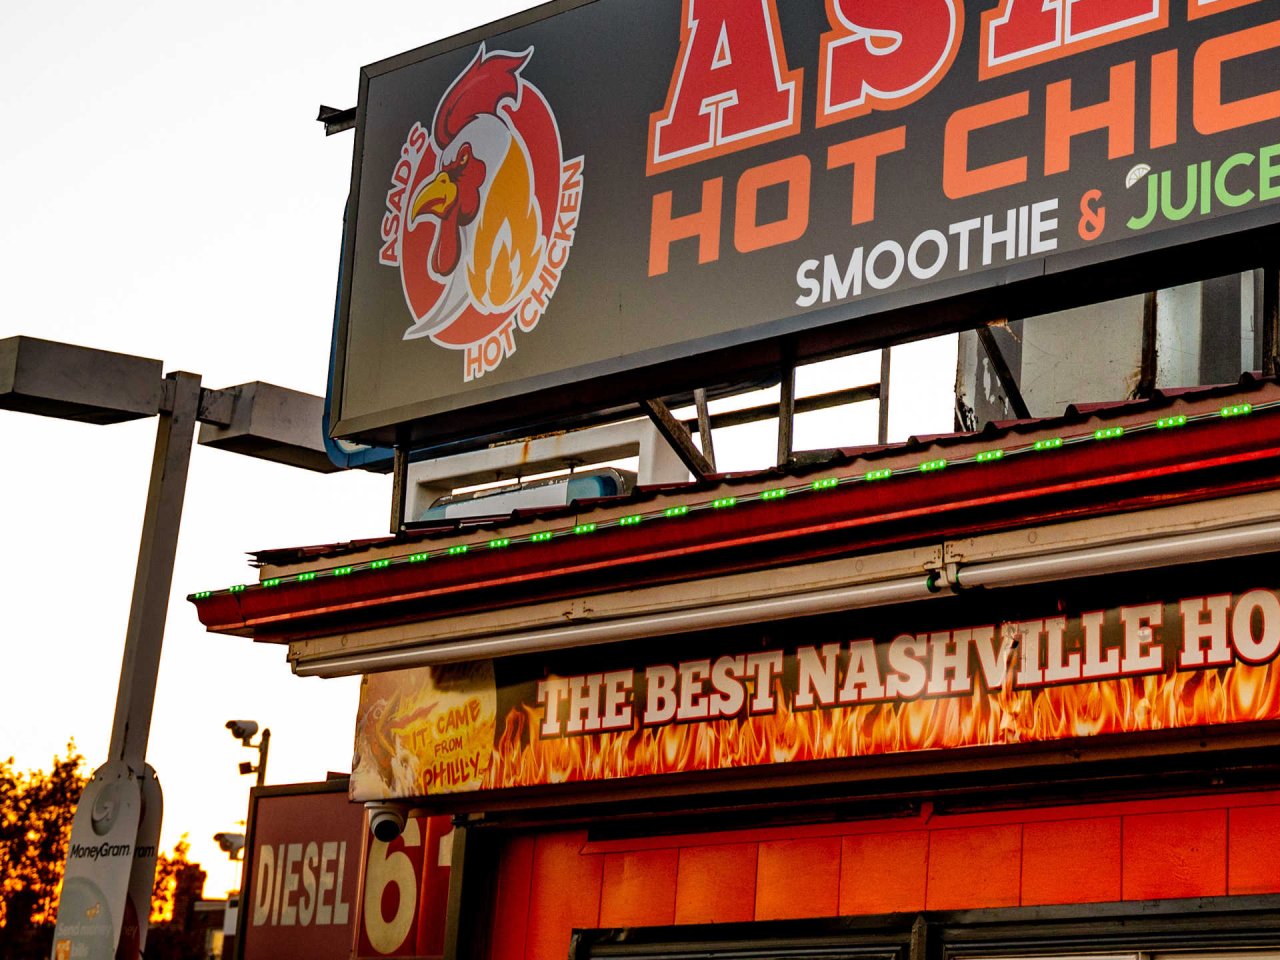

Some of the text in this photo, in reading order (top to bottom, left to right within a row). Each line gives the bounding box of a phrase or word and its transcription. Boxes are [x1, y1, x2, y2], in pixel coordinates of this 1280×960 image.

[380, 125, 428, 263] ASAD'S
[648, 124, 906, 276] HOT
[465, 159, 583, 378] HOT CHICKEN
[795, 198, 1059, 307] SMOOTHIE
[1078, 189, 1106, 241] &
[538, 669, 635, 738] THE
[644, 650, 784, 727] BEST
[794, 600, 1165, 709] NASHVILLE
[411, 699, 482, 751] IT CAME
[422, 751, 481, 796] PHILLY
[434, 737, 463, 757] FROM
[70, 842, 130, 861] MoneyGram
[253, 841, 349, 927] DIESEL
